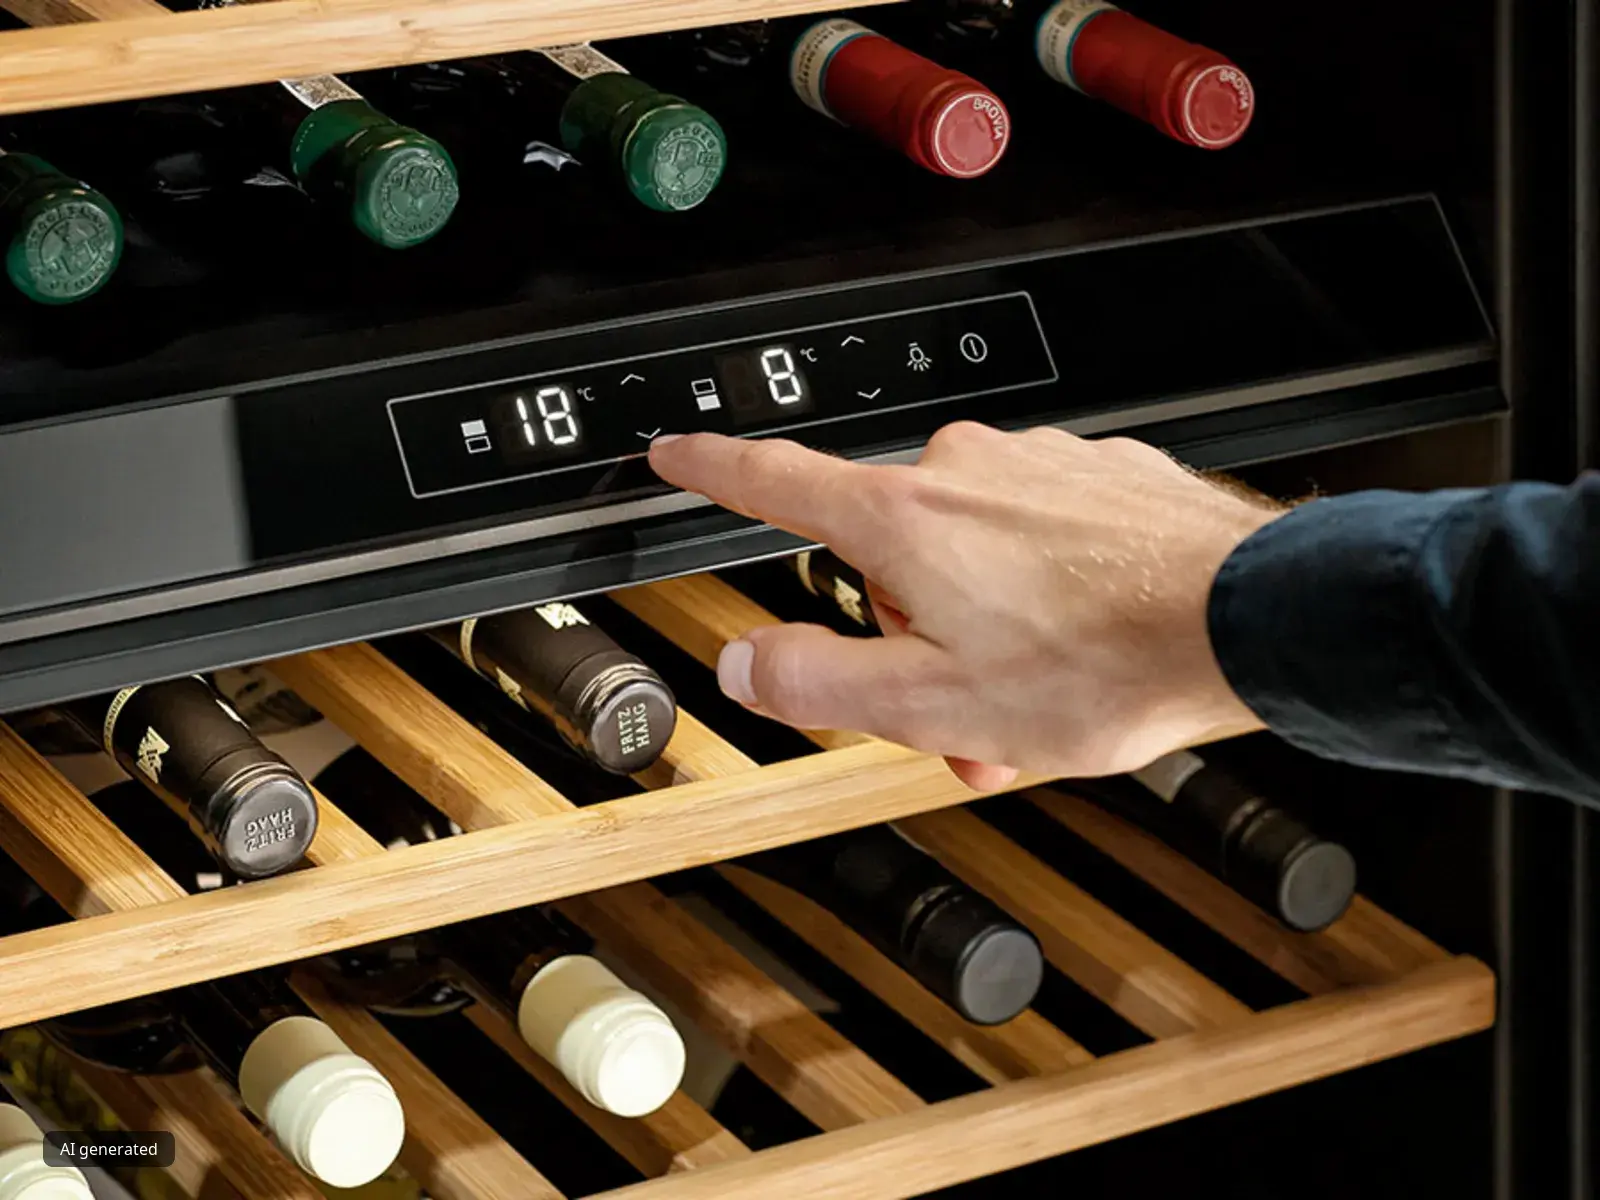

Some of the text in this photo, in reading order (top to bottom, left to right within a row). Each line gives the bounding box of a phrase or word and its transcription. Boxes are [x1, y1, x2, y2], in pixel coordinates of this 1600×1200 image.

[1220, 69, 1249, 110] BROVIA
[973, 96, 1003, 140] BROVIA
[760, 348, 802, 405] 8
[515, 387, 578, 445] 18
[617, 706, 636, 756] FRITZ
[632, 702, 651, 749] HAAG
[245, 807, 293, 837] HAAG
[246, 823, 296, 852] FRITZ
